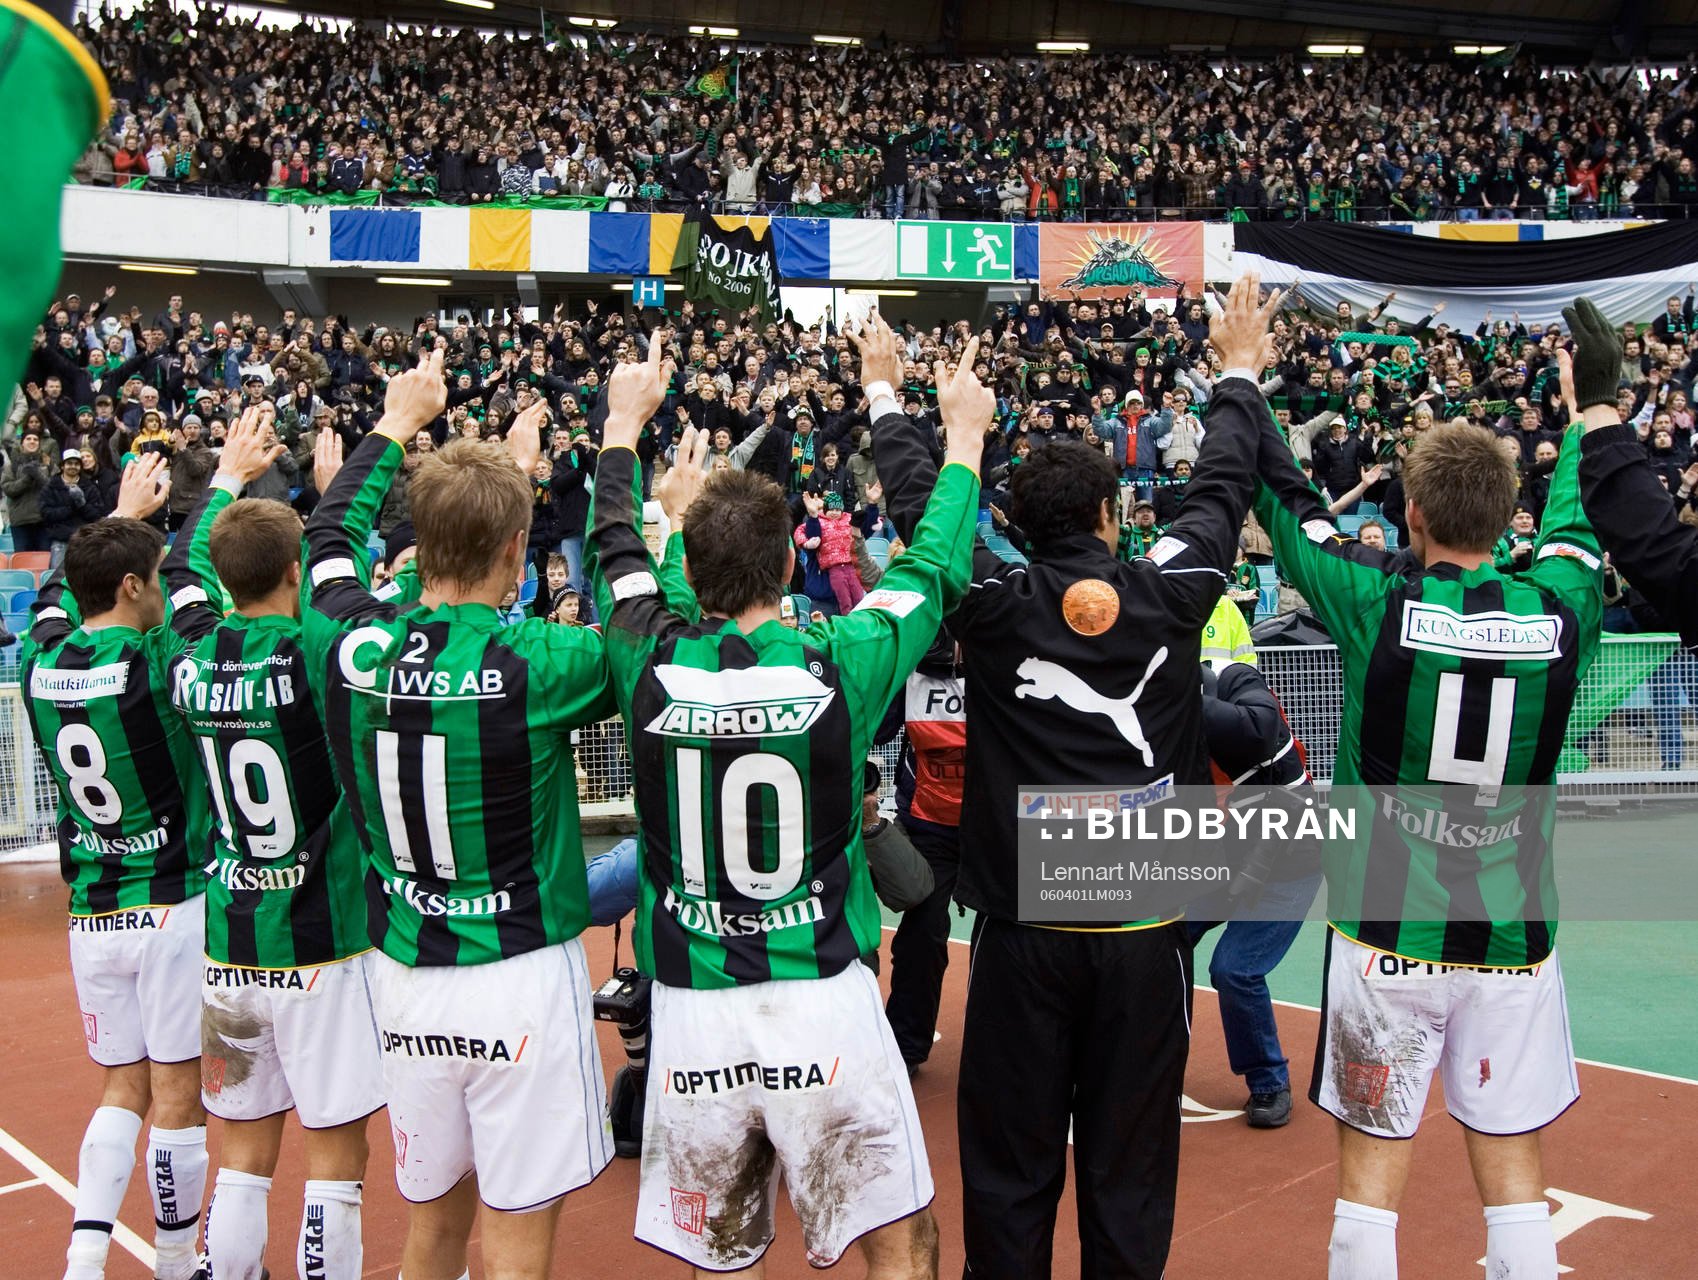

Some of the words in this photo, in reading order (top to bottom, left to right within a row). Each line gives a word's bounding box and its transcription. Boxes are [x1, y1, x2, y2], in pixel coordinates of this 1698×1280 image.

[640, 280, 657, 301] H
[1206, 625, 1216, 639] 9
[1416, 618, 1550, 644] KUNGSLEDEN
[398, 670, 450, 695] VVS
[458, 669, 503, 695] AB
[193, 718, 272, 729] www.roslov.se
[663, 702, 818, 734] ARROW
[1427, 672, 1516, 808] 4
[56, 723, 123, 824] 8
[200, 736, 296, 859] 19
[376, 730, 457, 880] 11
[676, 748, 805, 900] 10
[673, 1061, 825, 1094] OPTIMERA
